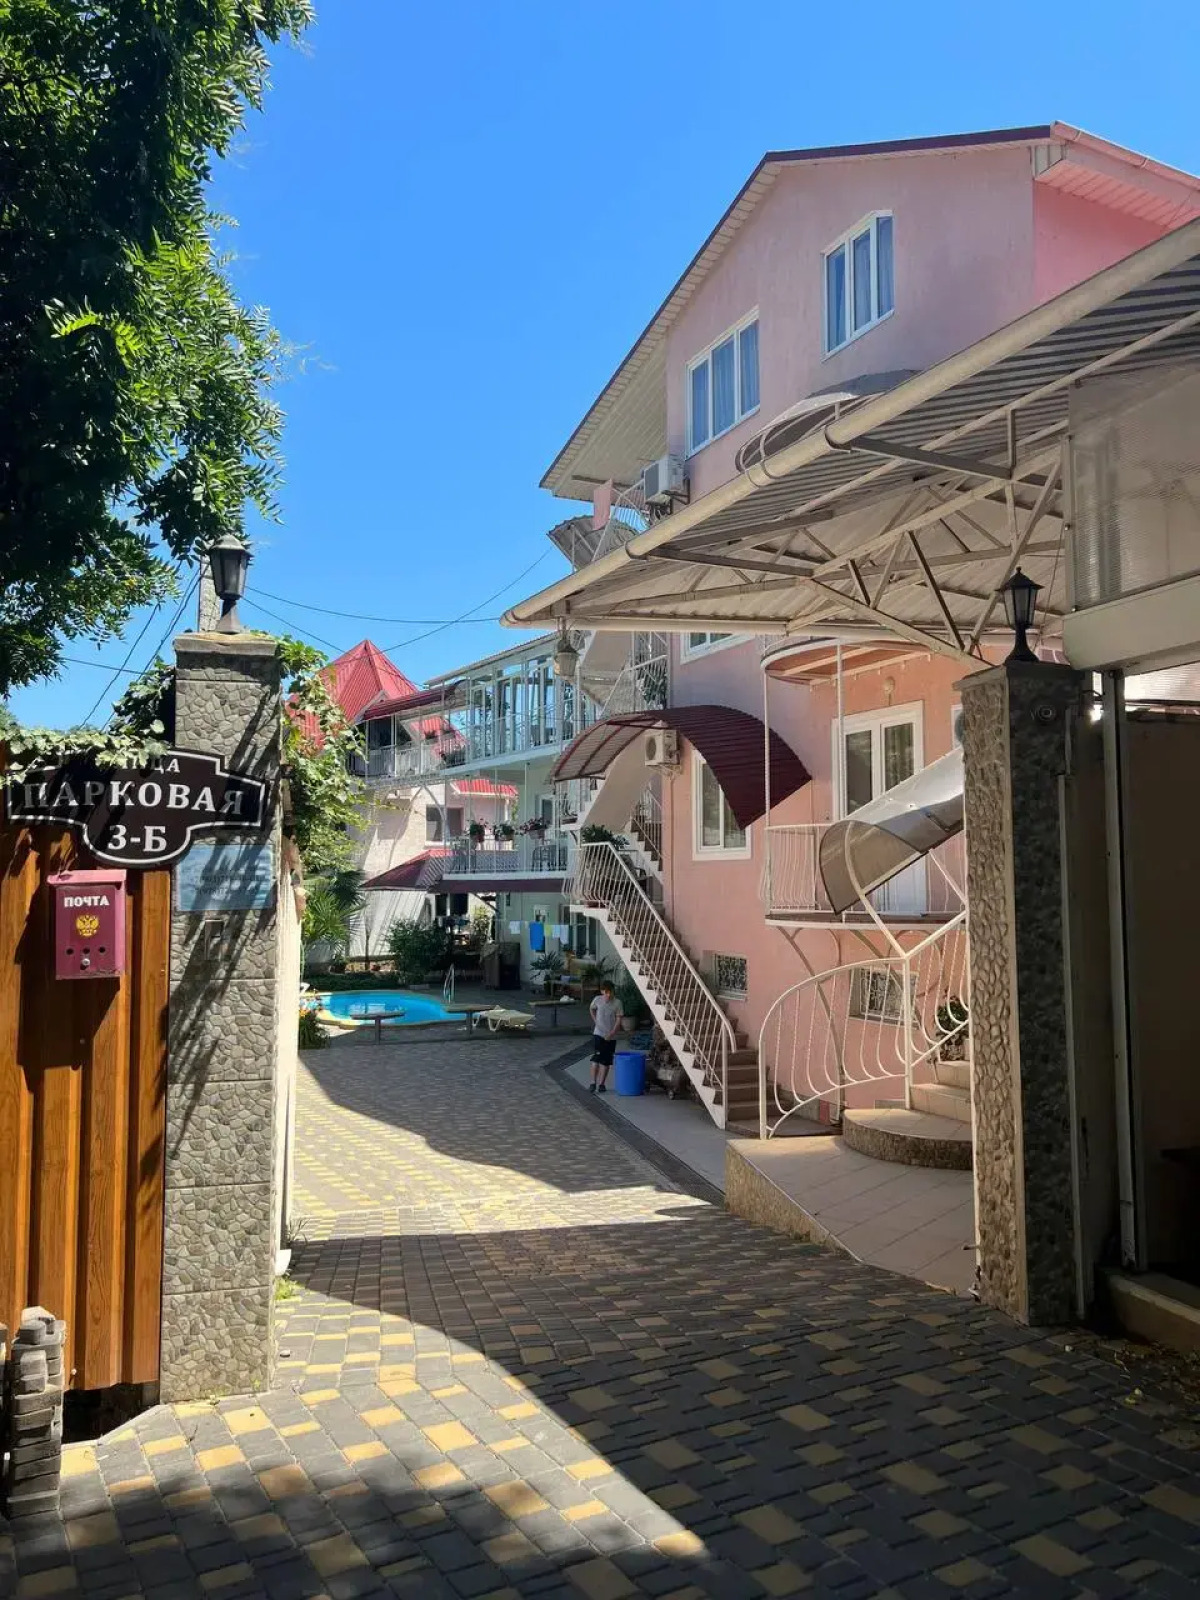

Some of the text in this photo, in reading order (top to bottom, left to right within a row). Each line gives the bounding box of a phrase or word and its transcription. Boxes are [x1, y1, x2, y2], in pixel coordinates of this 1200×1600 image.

[24, 781, 244, 815] ПАРКОВАЯ
[108, 824, 167, 852] 3-Б
[64, 895, 110, 908] ПОЧТА
